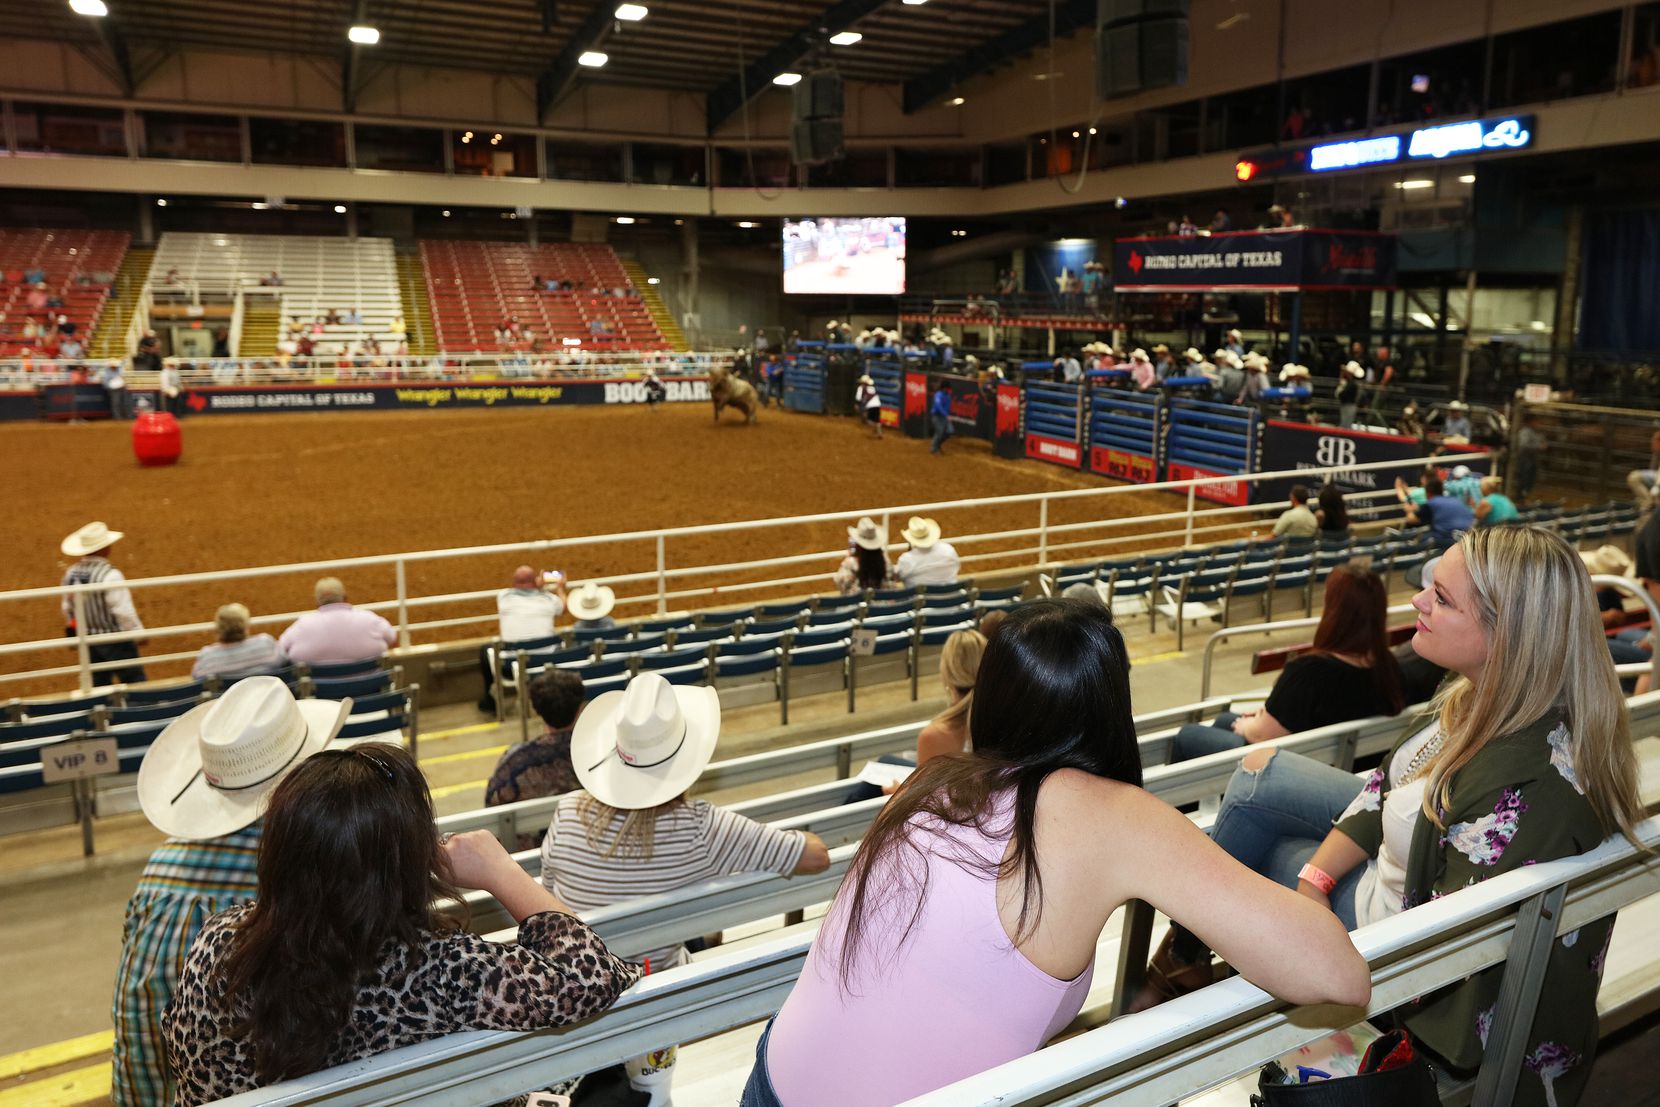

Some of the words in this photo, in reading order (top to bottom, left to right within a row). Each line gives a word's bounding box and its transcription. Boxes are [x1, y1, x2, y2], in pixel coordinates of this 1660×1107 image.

[1177, 253, 1224, 269] CAPITAL
[1224, 252, 1241, 268] OF
[1242, 251, 1283, 267] TEXAS
[256, 394, 313, 407] CAPITAL
[314, 393, 332, 406] OF
[333, 392, 376, 405] TEXAS
[395, 387, 452, 407] Wrangler
[453, 386, 509, 405] Wrangler
[510, 385, 563, 404] Wrangler
[604, 382, 649, 404] BOO
[53, 752, 86, 769] VIP
